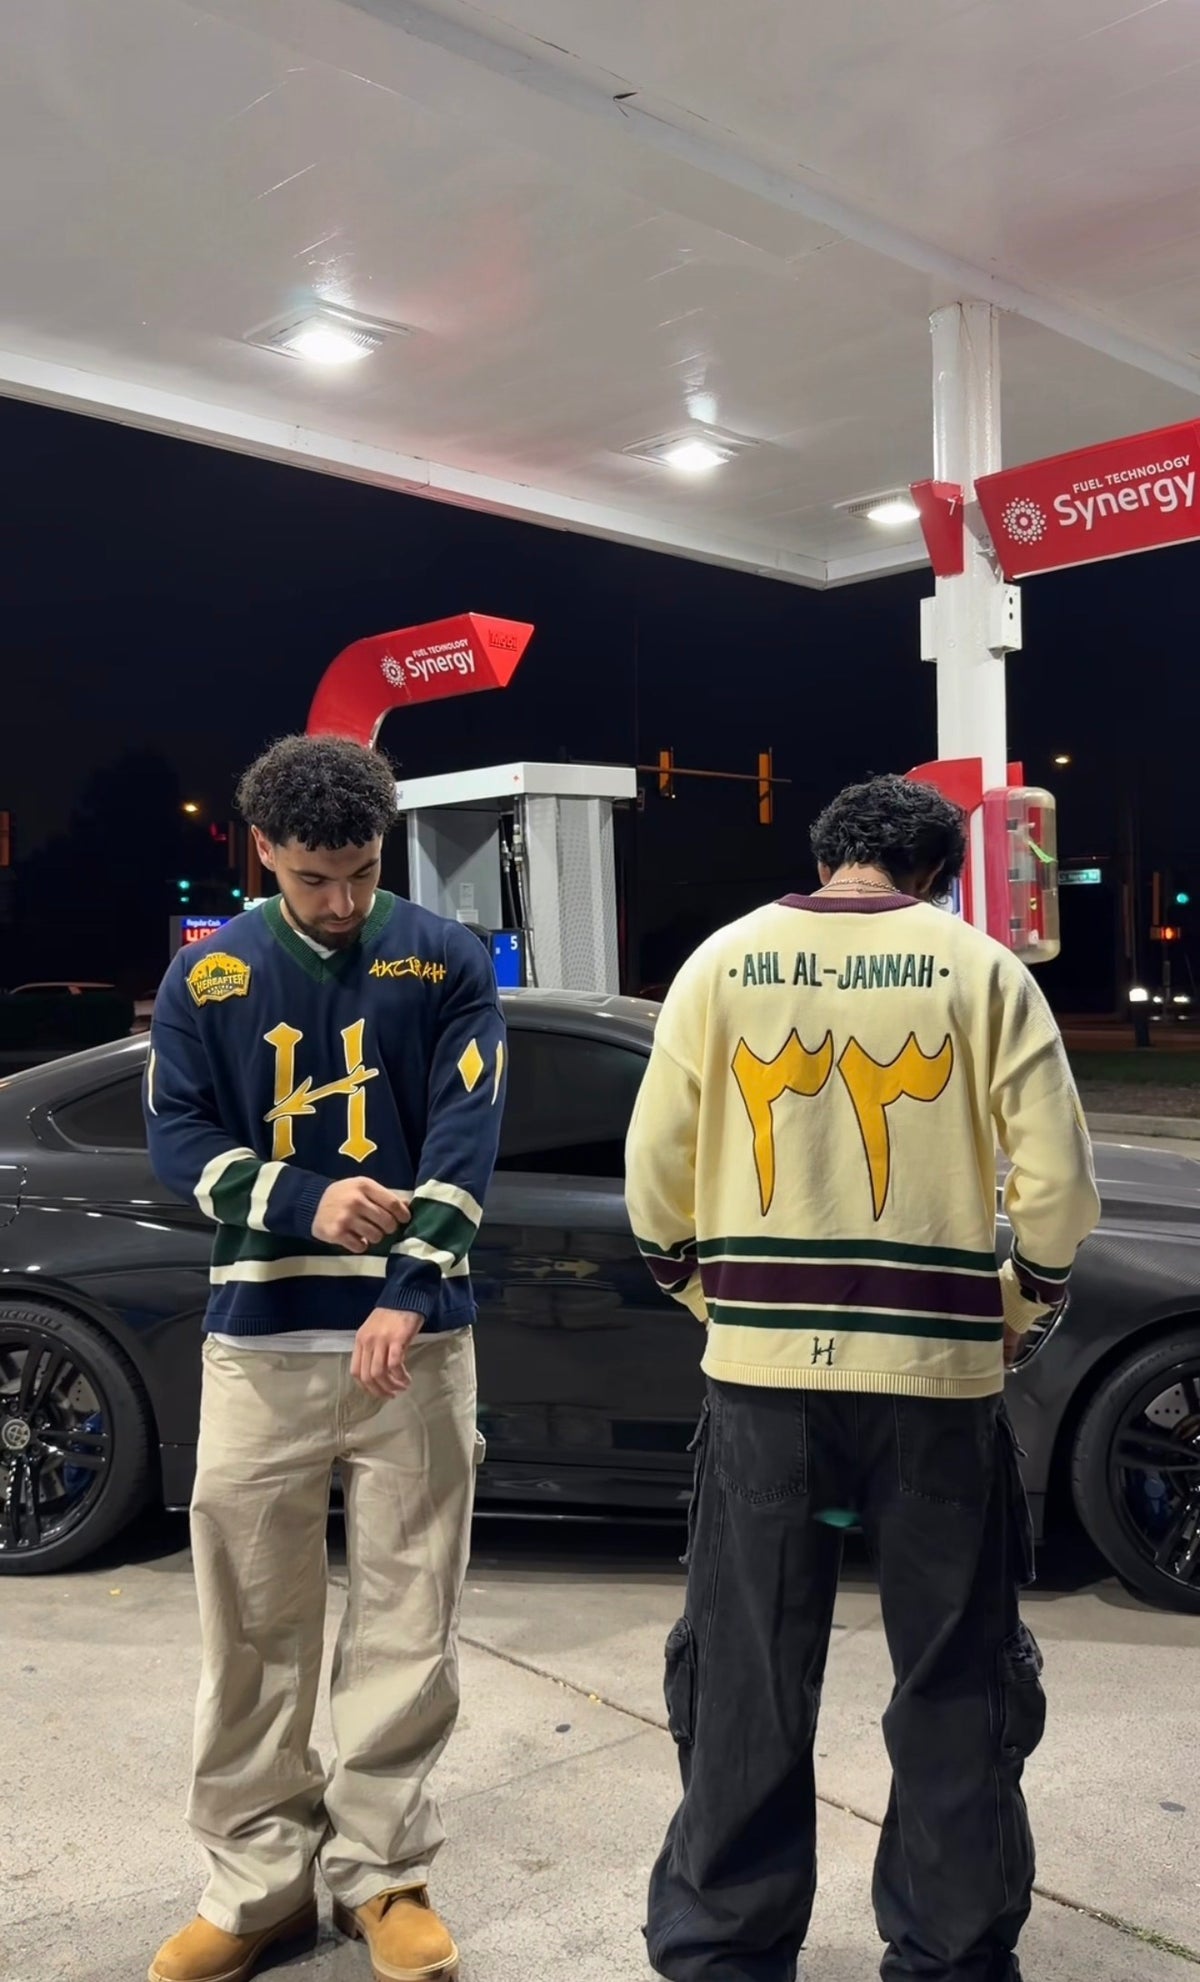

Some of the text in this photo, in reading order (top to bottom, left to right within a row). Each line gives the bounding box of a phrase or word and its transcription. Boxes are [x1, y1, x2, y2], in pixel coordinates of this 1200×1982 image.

[1073, 455, 1191, 494] FUEL TECHNOLOGY
[1053, 471, 1196, 531] Synergy
[412, 638, 468, 658] FUEL TECHNOLOGY
[405, 649, 475, 682] Synergy
[510, 935, 518, 951] 5
[194, 974, 244, 995] HEREAFTER
[742, 951, 786, 988] AHL
[263, 1018, 380, 1162] H
[0, 1310, 63, 1331] ICHELIN
[811, 1336, 836, 1366] H
